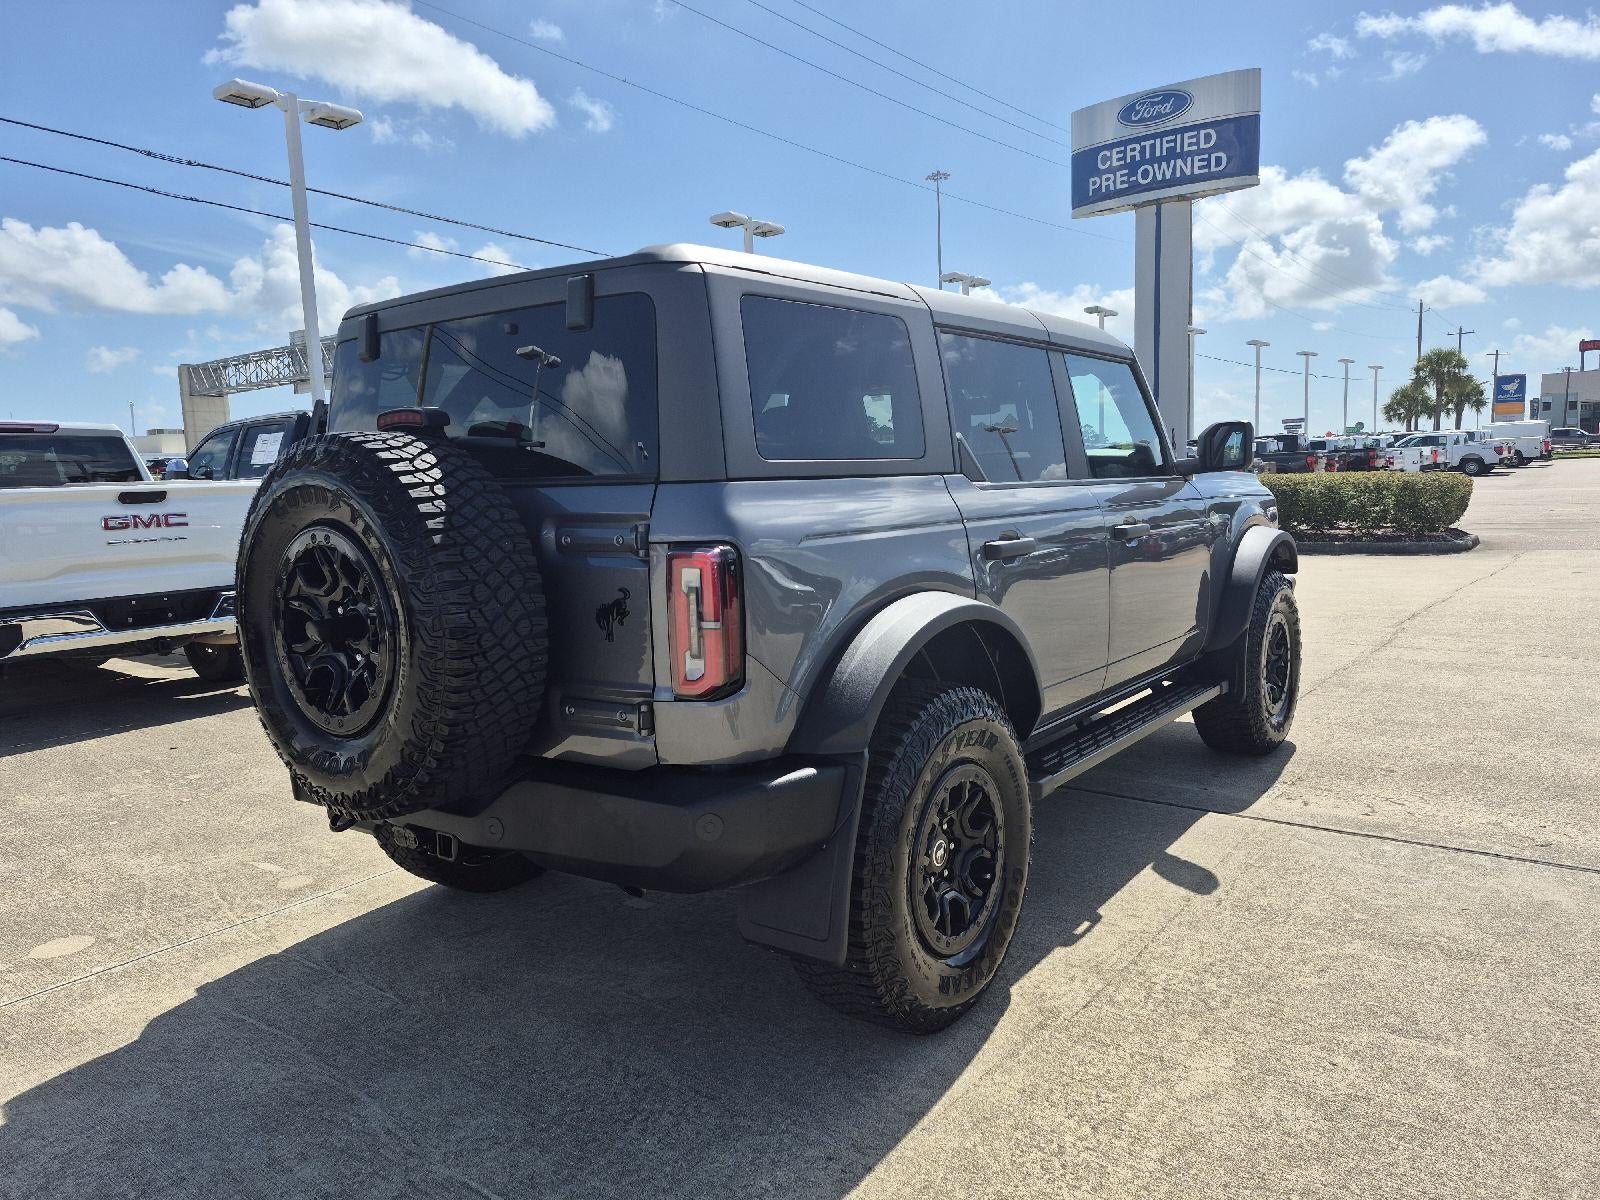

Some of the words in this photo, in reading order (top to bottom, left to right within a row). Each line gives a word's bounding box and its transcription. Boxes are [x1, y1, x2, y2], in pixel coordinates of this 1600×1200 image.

[1131, 95, 1174, 121] Ford
[1097, 128, 1217, 170] CERTIFIED
[1088, 152, 1228, 196] PRE-OWNED
[102, 512, 188, 530] GMC
